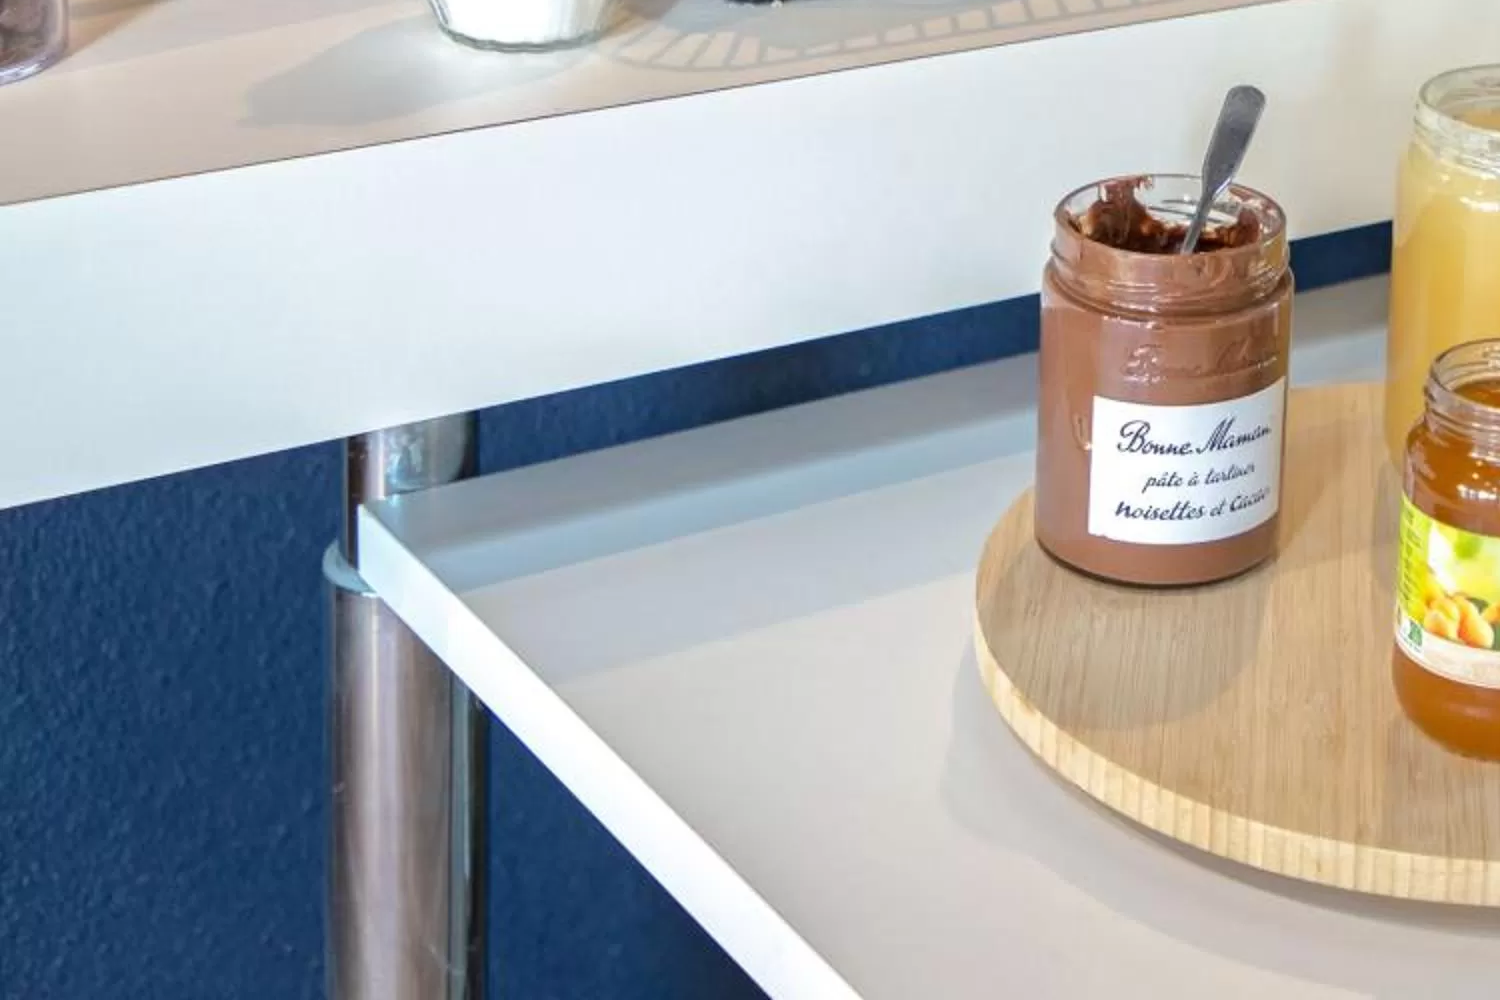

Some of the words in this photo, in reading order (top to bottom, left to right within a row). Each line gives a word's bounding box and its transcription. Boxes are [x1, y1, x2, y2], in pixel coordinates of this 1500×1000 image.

[1117, 420, 1192, 455] Bonne
[1195, 416, 1271, 454] Maman
[1209, 498, 1227, 517] et
